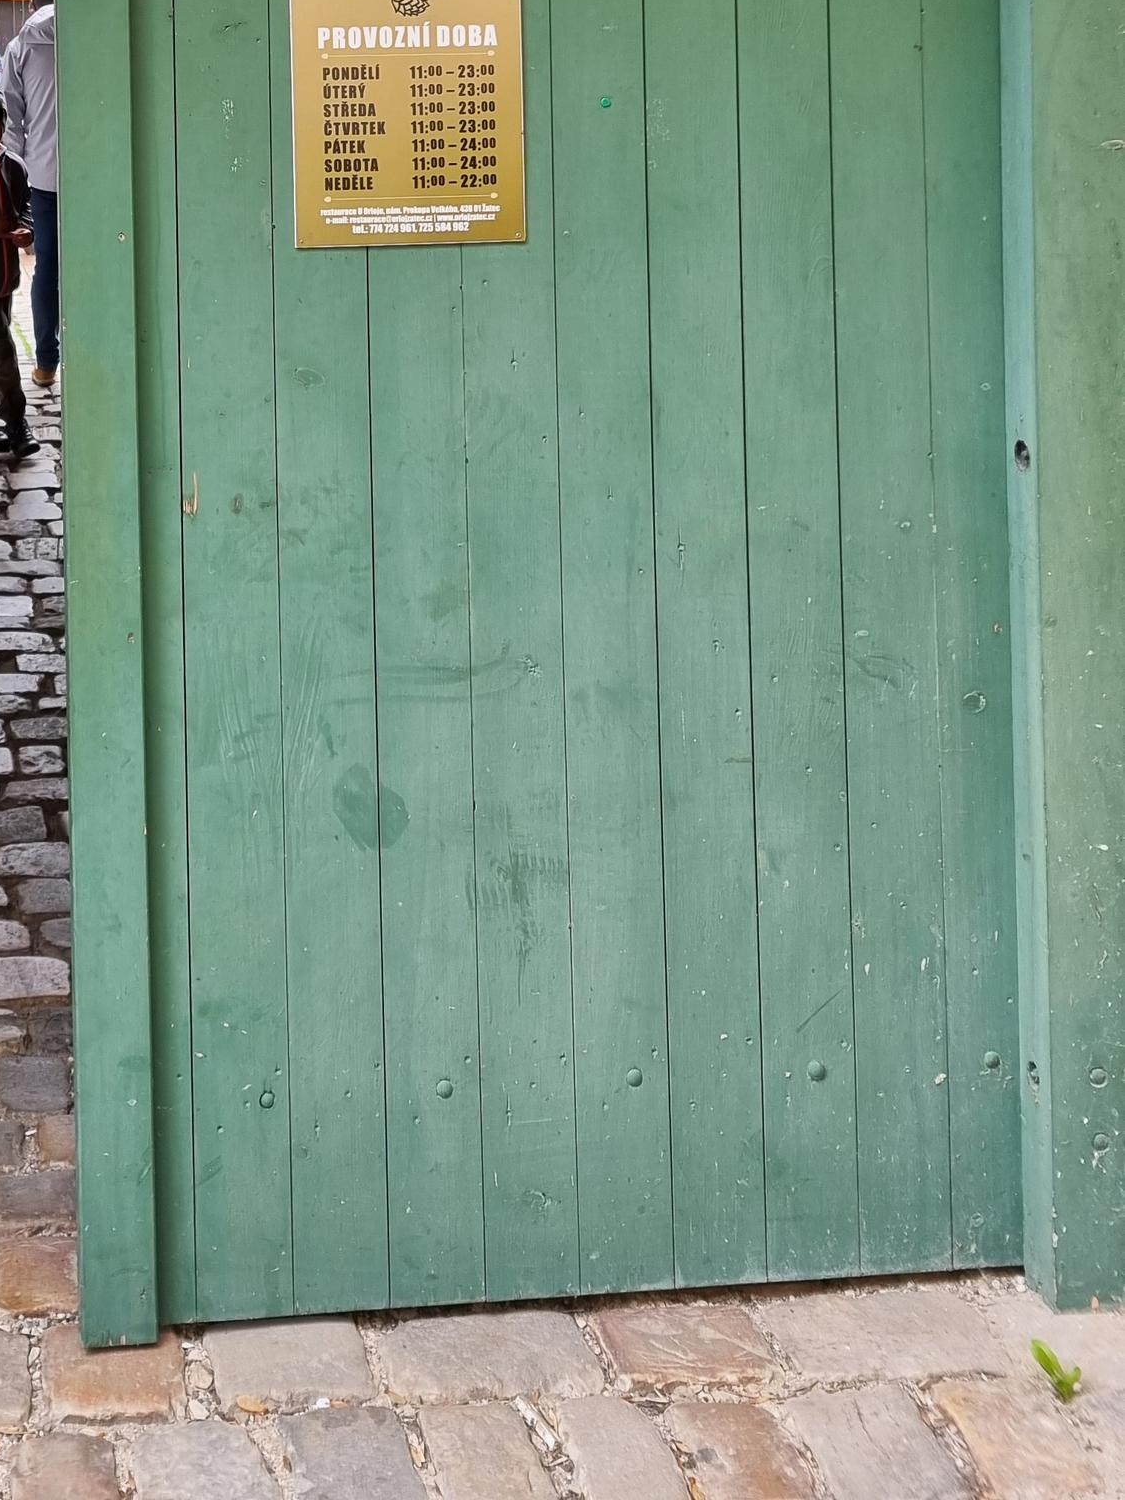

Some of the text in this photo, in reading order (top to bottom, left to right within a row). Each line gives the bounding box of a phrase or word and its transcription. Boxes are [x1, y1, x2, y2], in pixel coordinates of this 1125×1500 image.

[317, 22, 498, 49] PROVOZNÍ DOBA
[323, 65, 379, 80] PONDĚLÍ
[410, 65, 442, 79] 11:00
[458, 65, 494, 78] 23:00
[323, 83, 365, 98] ÚTERÝ
[410, 84, 442, 97] 11:00
[458, 83, 495, 96] 23:00
[324, 101, 376, 117] STŘEDA
[410, 102, 443, 115] 11:00
[459, 101, 495, 114] 23:00
[324, 120, 386, 136] ČTVRTEK
[411, 120, 443, 134] 11:00
[459, 119, 495, 133] 23:00
[324, 138, 365, 154] PÁTEK
[412, 139, 444, 152] 11:00
[460, 138, 496, 151] 24:00
[325, 158, 379, 172] SOBOTA
[412, 157, 445, 170] 11:00
[461, 156, 496, 169] 24:00
[325, 175, 373, 191] NEDĚLE
[412, 175, 445, 189] 11:00
[461, 174, 496, 188] 22:00
[369, 225, 383, 233] 774
[384, 224, 398, 233] 724
[418, 223, 434, 232] 725
[435, 222, 451, 232] 584
[453, 222, 469, 232] 962
